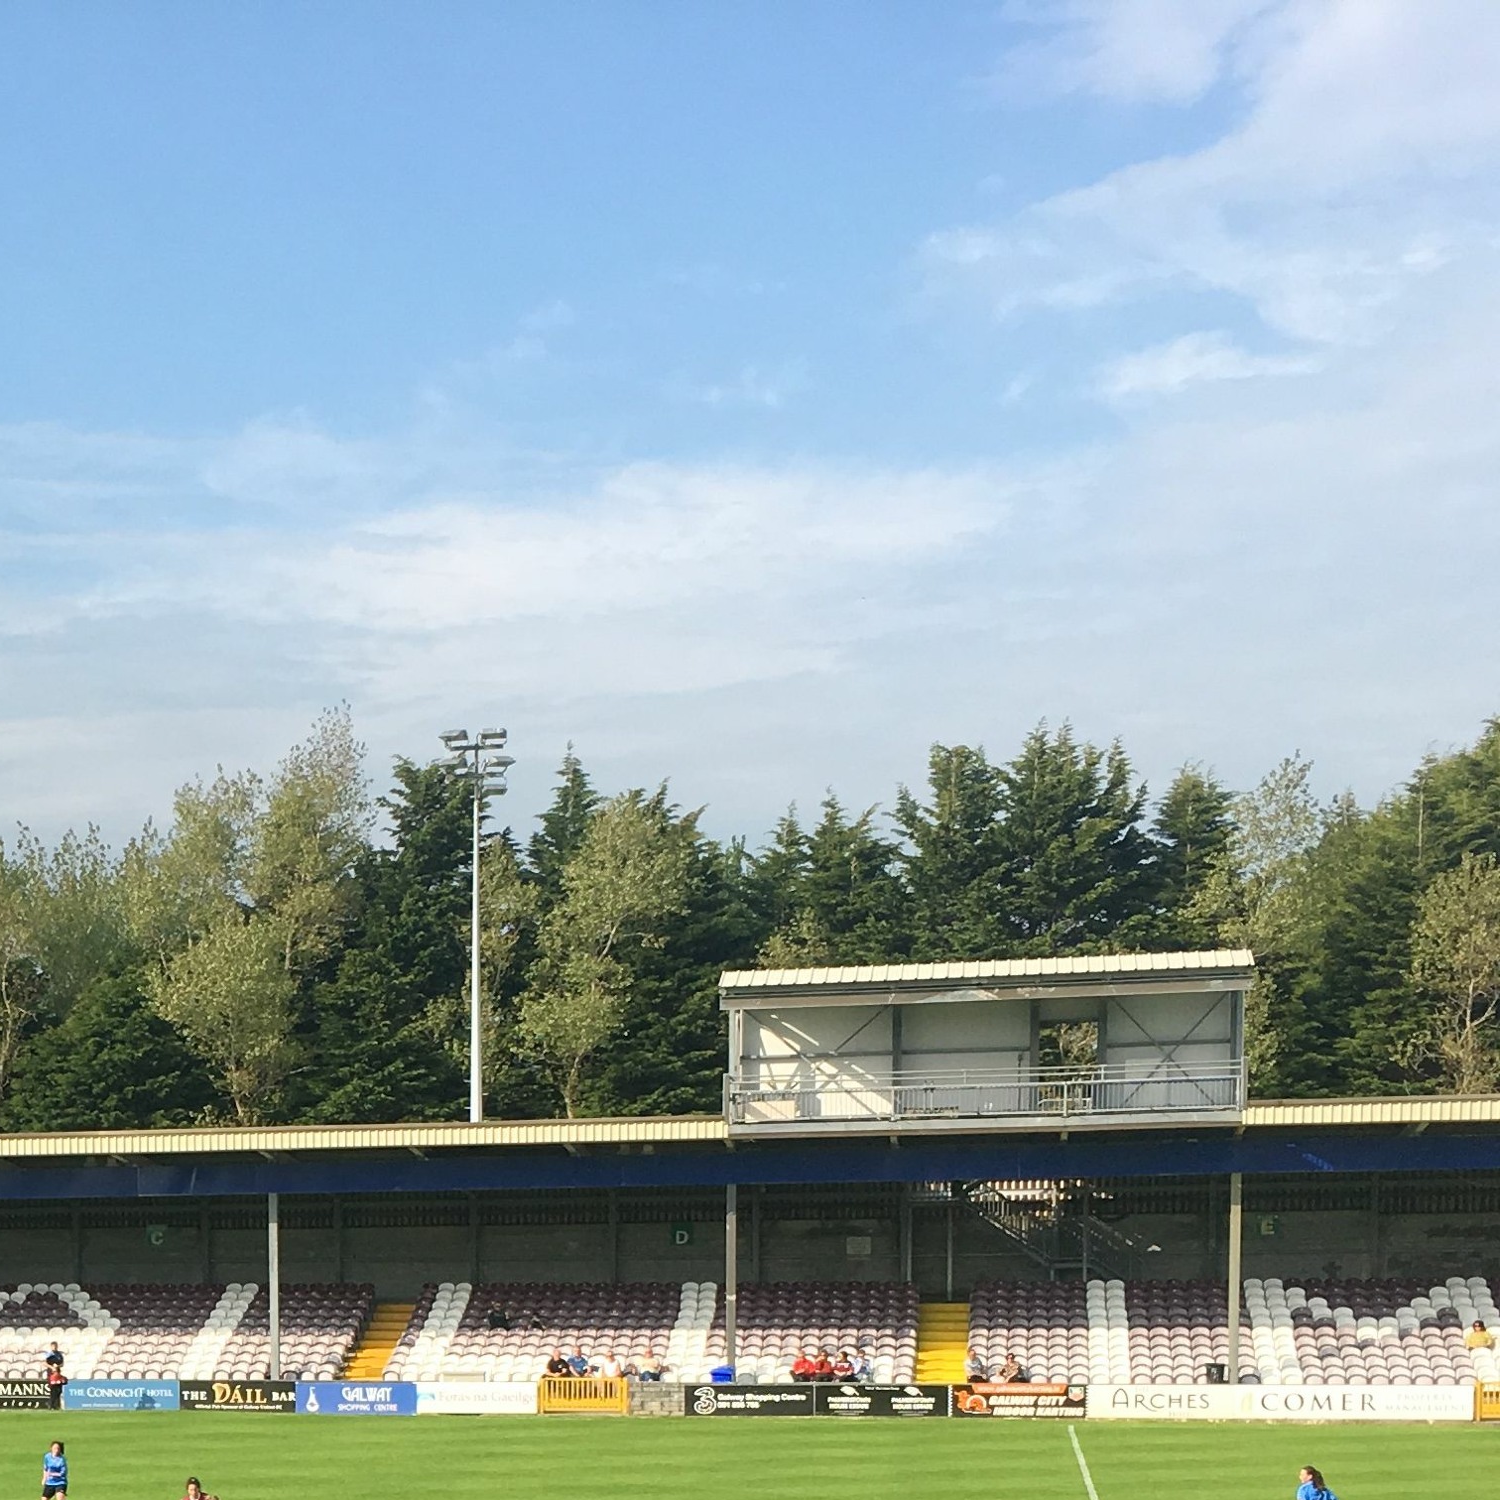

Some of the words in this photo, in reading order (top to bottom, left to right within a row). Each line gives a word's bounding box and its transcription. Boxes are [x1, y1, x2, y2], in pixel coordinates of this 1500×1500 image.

[150, 1230, 164, 1244] C
[675, 1229, 689, 1244] D
[69, 1387, 84, 1396] THE
[87, 1385, 146, 1398] CONNACHT
[146, 1387, 173, 1397] HOTEL
[182, 1390, 207, 1401] THE
[212, 1383, 267, 1404] DÁIL
[272, 1391, 296, 1401] BAR
[341, 1387, 392, 1402] GALWAY
[473, 1393, 487, 1401] na
[717, 1392, 744, 1401] Galway
[745, 1392, 780, 1402] Shopping
[781, 1392, 806, 1400] Centre
[988, 1395, 1037, 1405] GALWAY
[1037, 1395, 1067, 1405] CITY
[1112, 1388, 1209, 1412] ARCHES
[1261, 1393, 1376, 1412] COMER
[338, 1403, 370, 1412] SHOPPING
[374, 1403, 398, 1412] CENTRE
